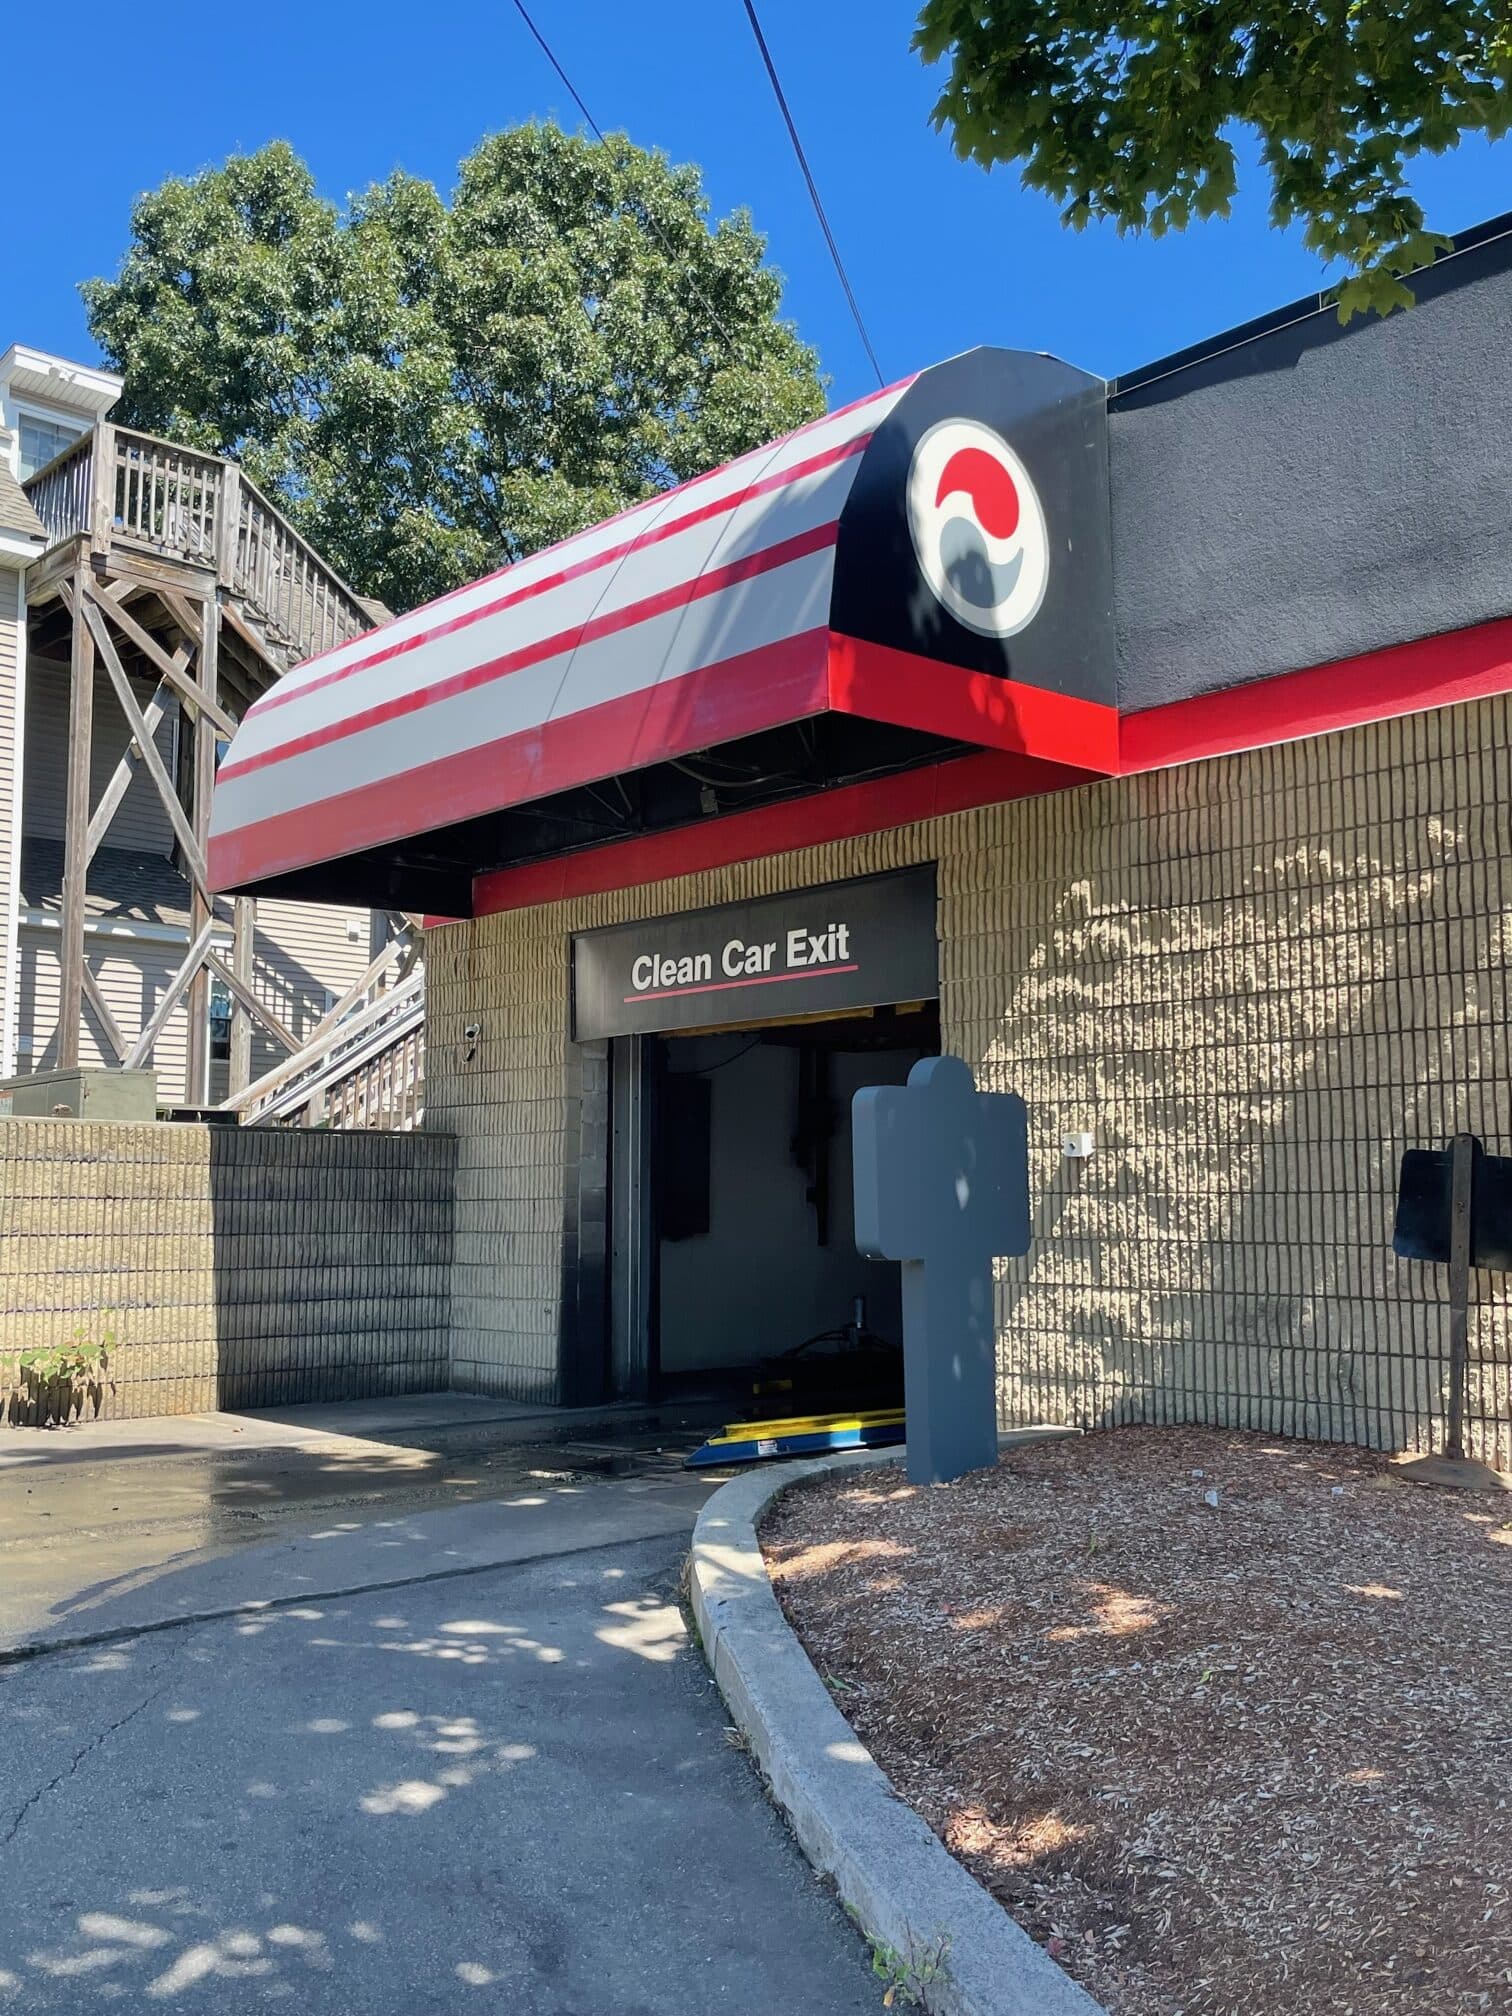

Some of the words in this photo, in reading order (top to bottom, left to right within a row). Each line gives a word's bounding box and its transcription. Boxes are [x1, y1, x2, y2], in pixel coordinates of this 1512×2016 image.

[631, 953, 712, 991] Clean
[721, 939, 777, 977] Car
[786, 923, 850, 968] Exit
